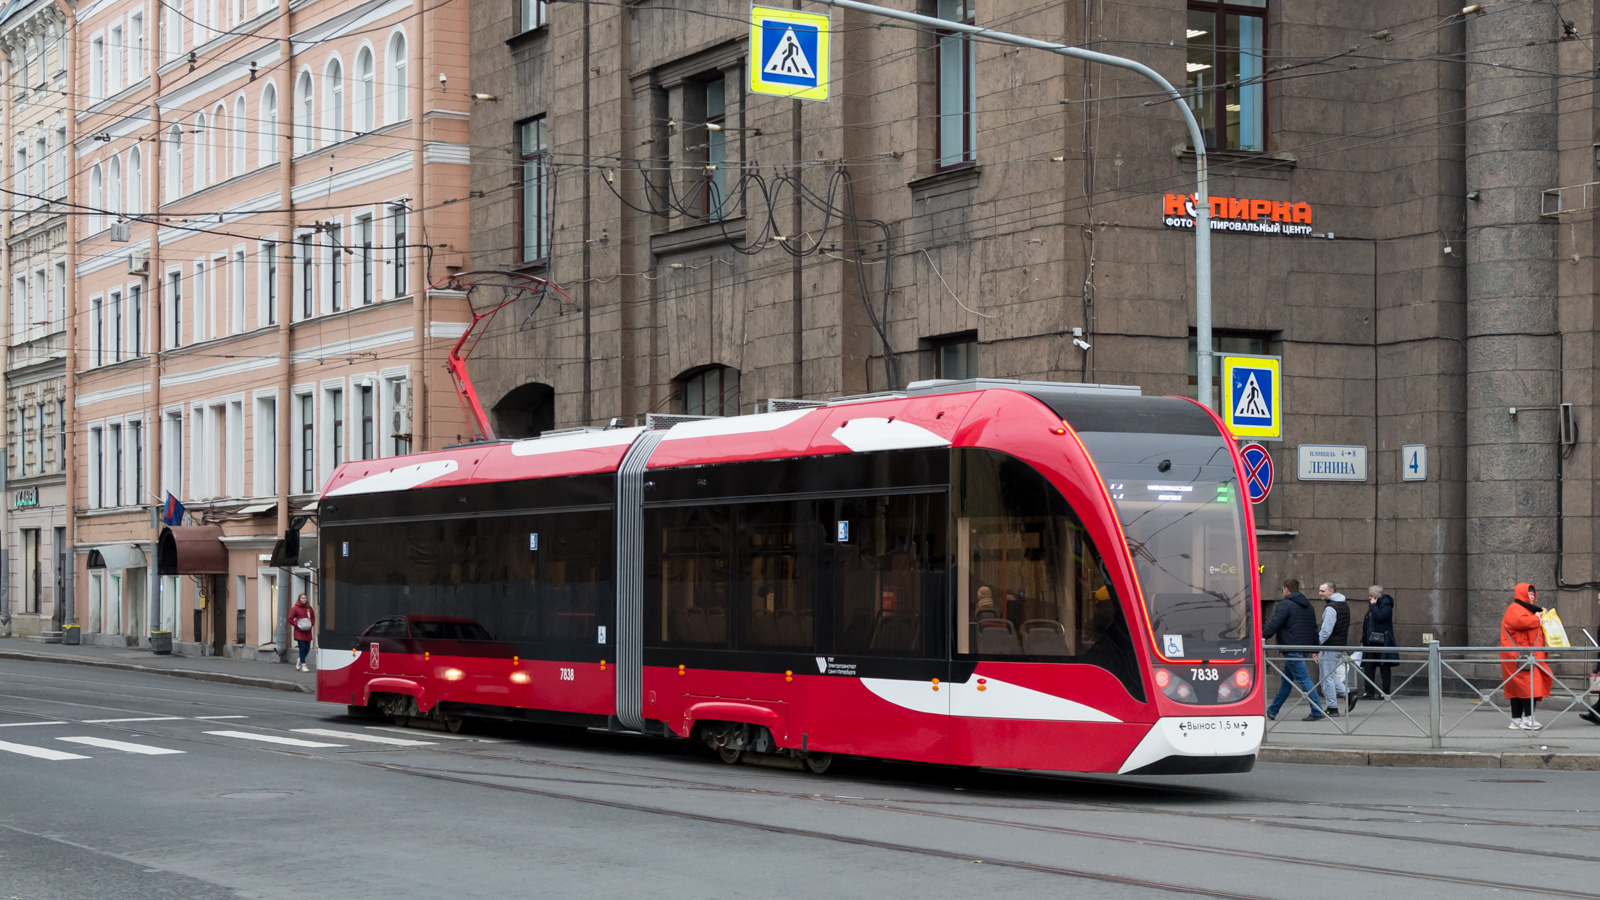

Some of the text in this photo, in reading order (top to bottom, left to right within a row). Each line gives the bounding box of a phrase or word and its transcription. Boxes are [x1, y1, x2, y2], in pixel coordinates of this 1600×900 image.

[1165, 217, 1312, 236] ФОТОПИРОВАЛЬНЫЙ ЦЕНТР
[1308, 461, 1356, 474] ЛЕНИНА
[1409, 450, 1419, 474] 4
[560, 668, 574, 681] 7838
[1190, 668, 1219, 681] 7838
[1187, 721, 1216, 730] Вынос
[1219, 720, 1232, 731] 1,5
